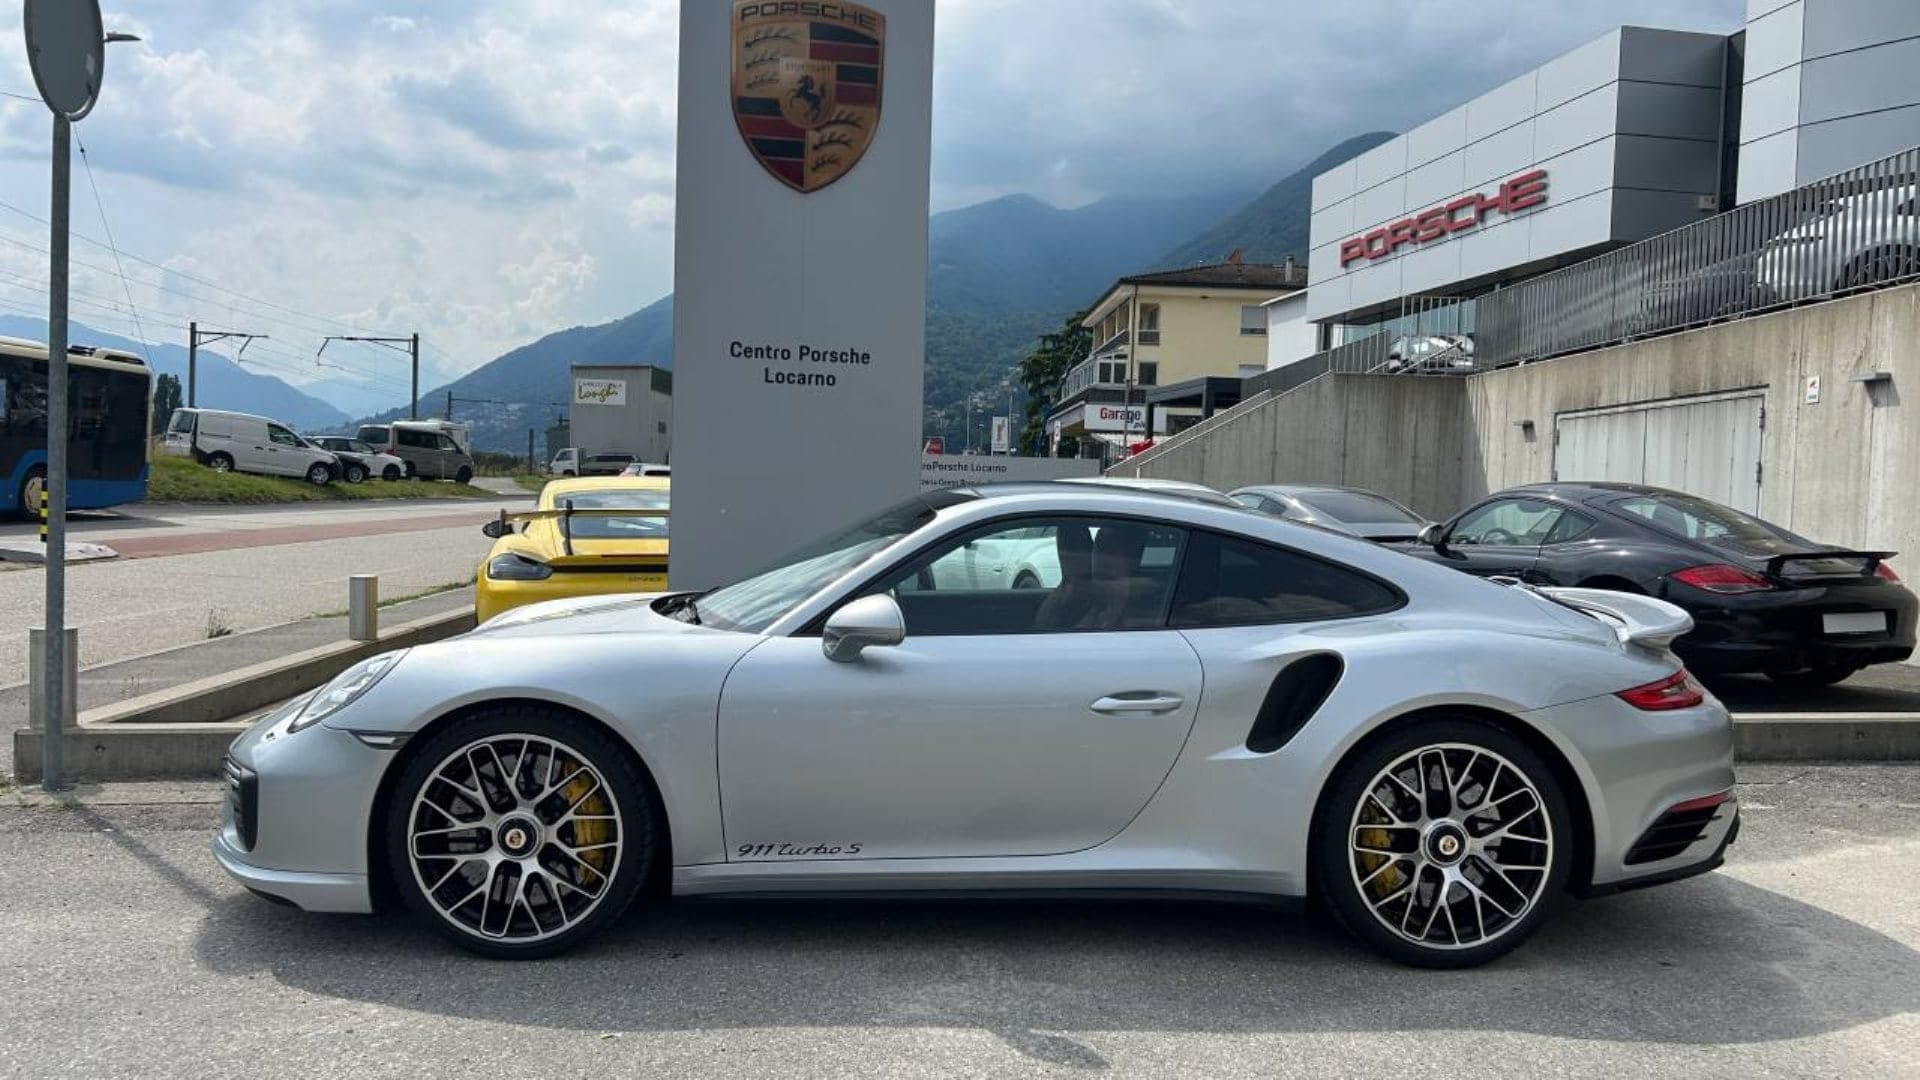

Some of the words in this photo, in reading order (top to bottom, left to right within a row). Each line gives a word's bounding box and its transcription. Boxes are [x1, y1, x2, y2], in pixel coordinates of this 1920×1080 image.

[740, 2, 877, 31] PORSCHE
[1340, 169, 1548, 267] PORSCHE
[730, 341, 791, 361] Centro
[799, 345, 871, 365] Porsche
[764, 367, 837, 387] Locarno
[1100, 407, 1142, 425] Garage
[971, 462, 1008, 473] Locarno
[737, 843, 775, 857] 911
[843, 843, 864, 854] S
